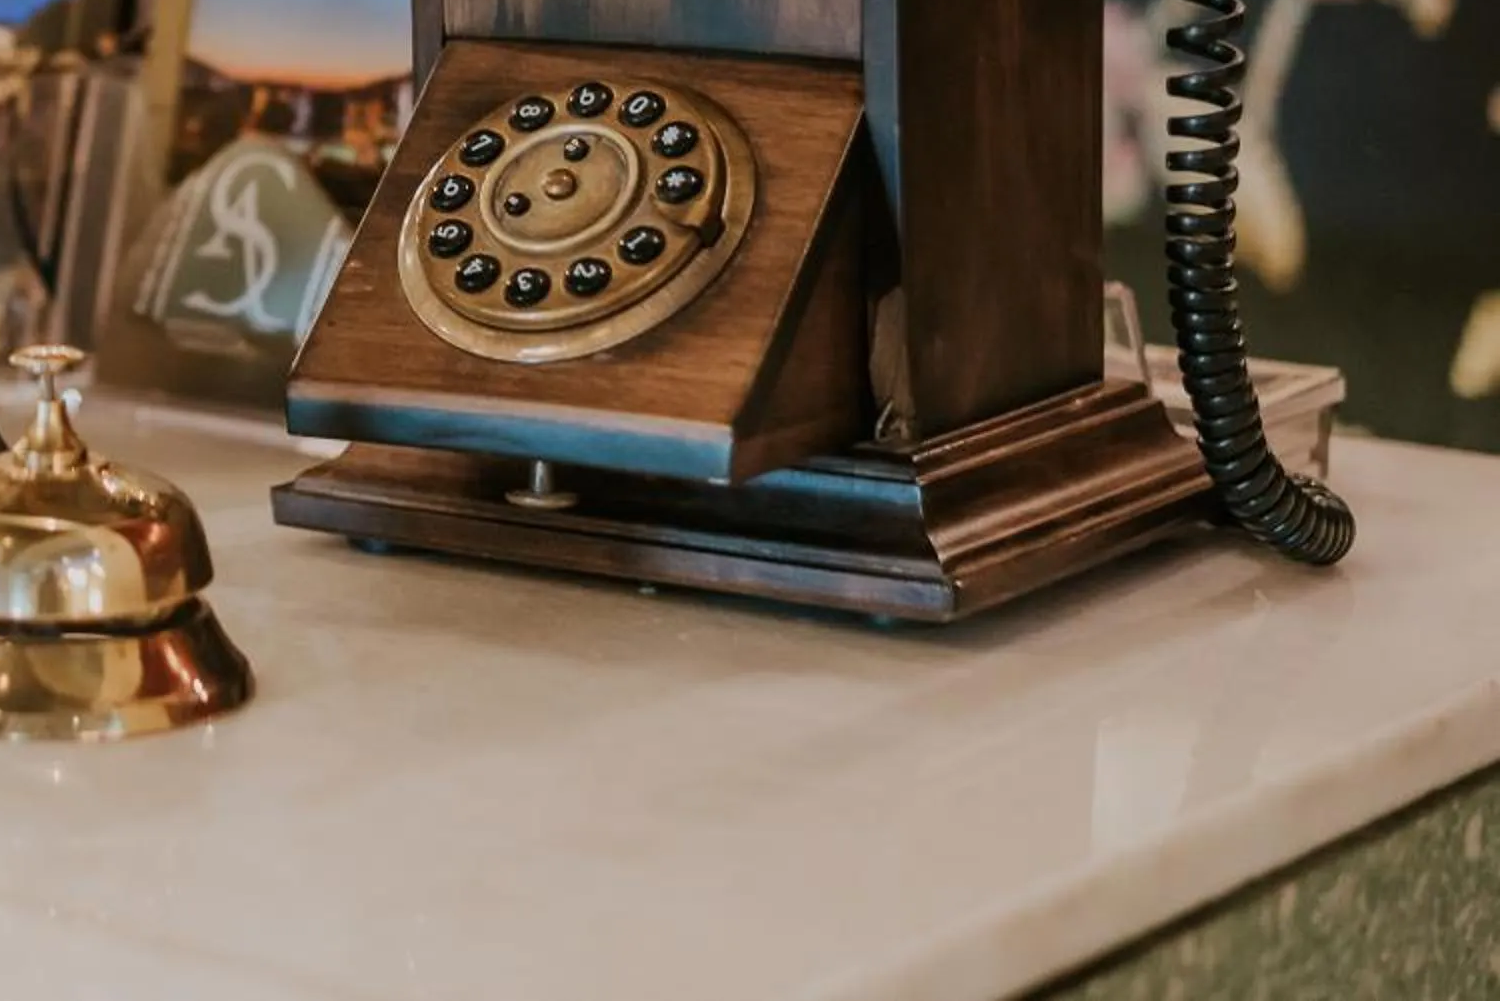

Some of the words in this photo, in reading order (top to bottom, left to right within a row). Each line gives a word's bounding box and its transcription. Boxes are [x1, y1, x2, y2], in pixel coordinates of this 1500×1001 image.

[519, 104, 540, 117] 8
[629, 96, 648, 115] 0
[471, 134, 493, 152] 7
[443, 178, 459, 196] 6
[437, 225, 459, 239] 5
[626, 231, 647, 250] 1
[462, 258, 484, 276] 4
[573, 262, 597, 278] 2
[516, 271, 534, 291] 3
